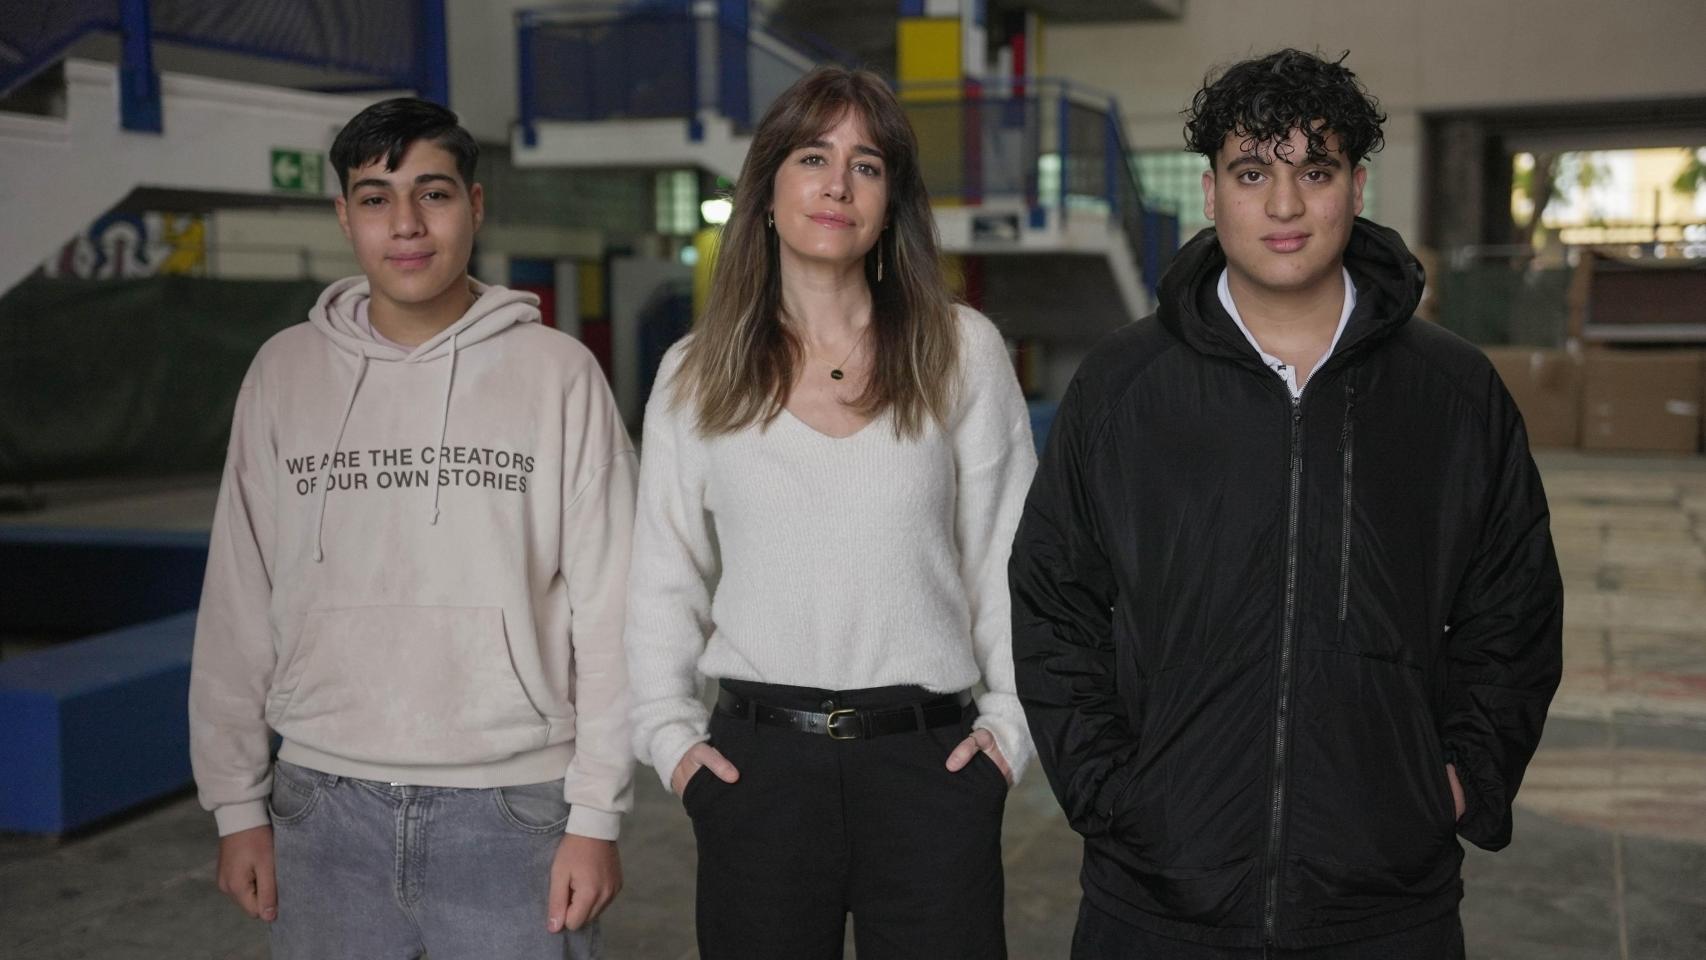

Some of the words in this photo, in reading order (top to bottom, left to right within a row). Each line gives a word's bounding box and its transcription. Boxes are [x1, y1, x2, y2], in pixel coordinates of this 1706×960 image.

[286, 455, 315, 475] WE
[320, 451, 361, 470] ARE
[368, 448, 413, 467] THE
[421, 446, 535, 473] CREATORS
[297, 476, 317, 495] OF
[376, 470, 429, 489] OWN
[438, 468, 527, 493] STORIES
